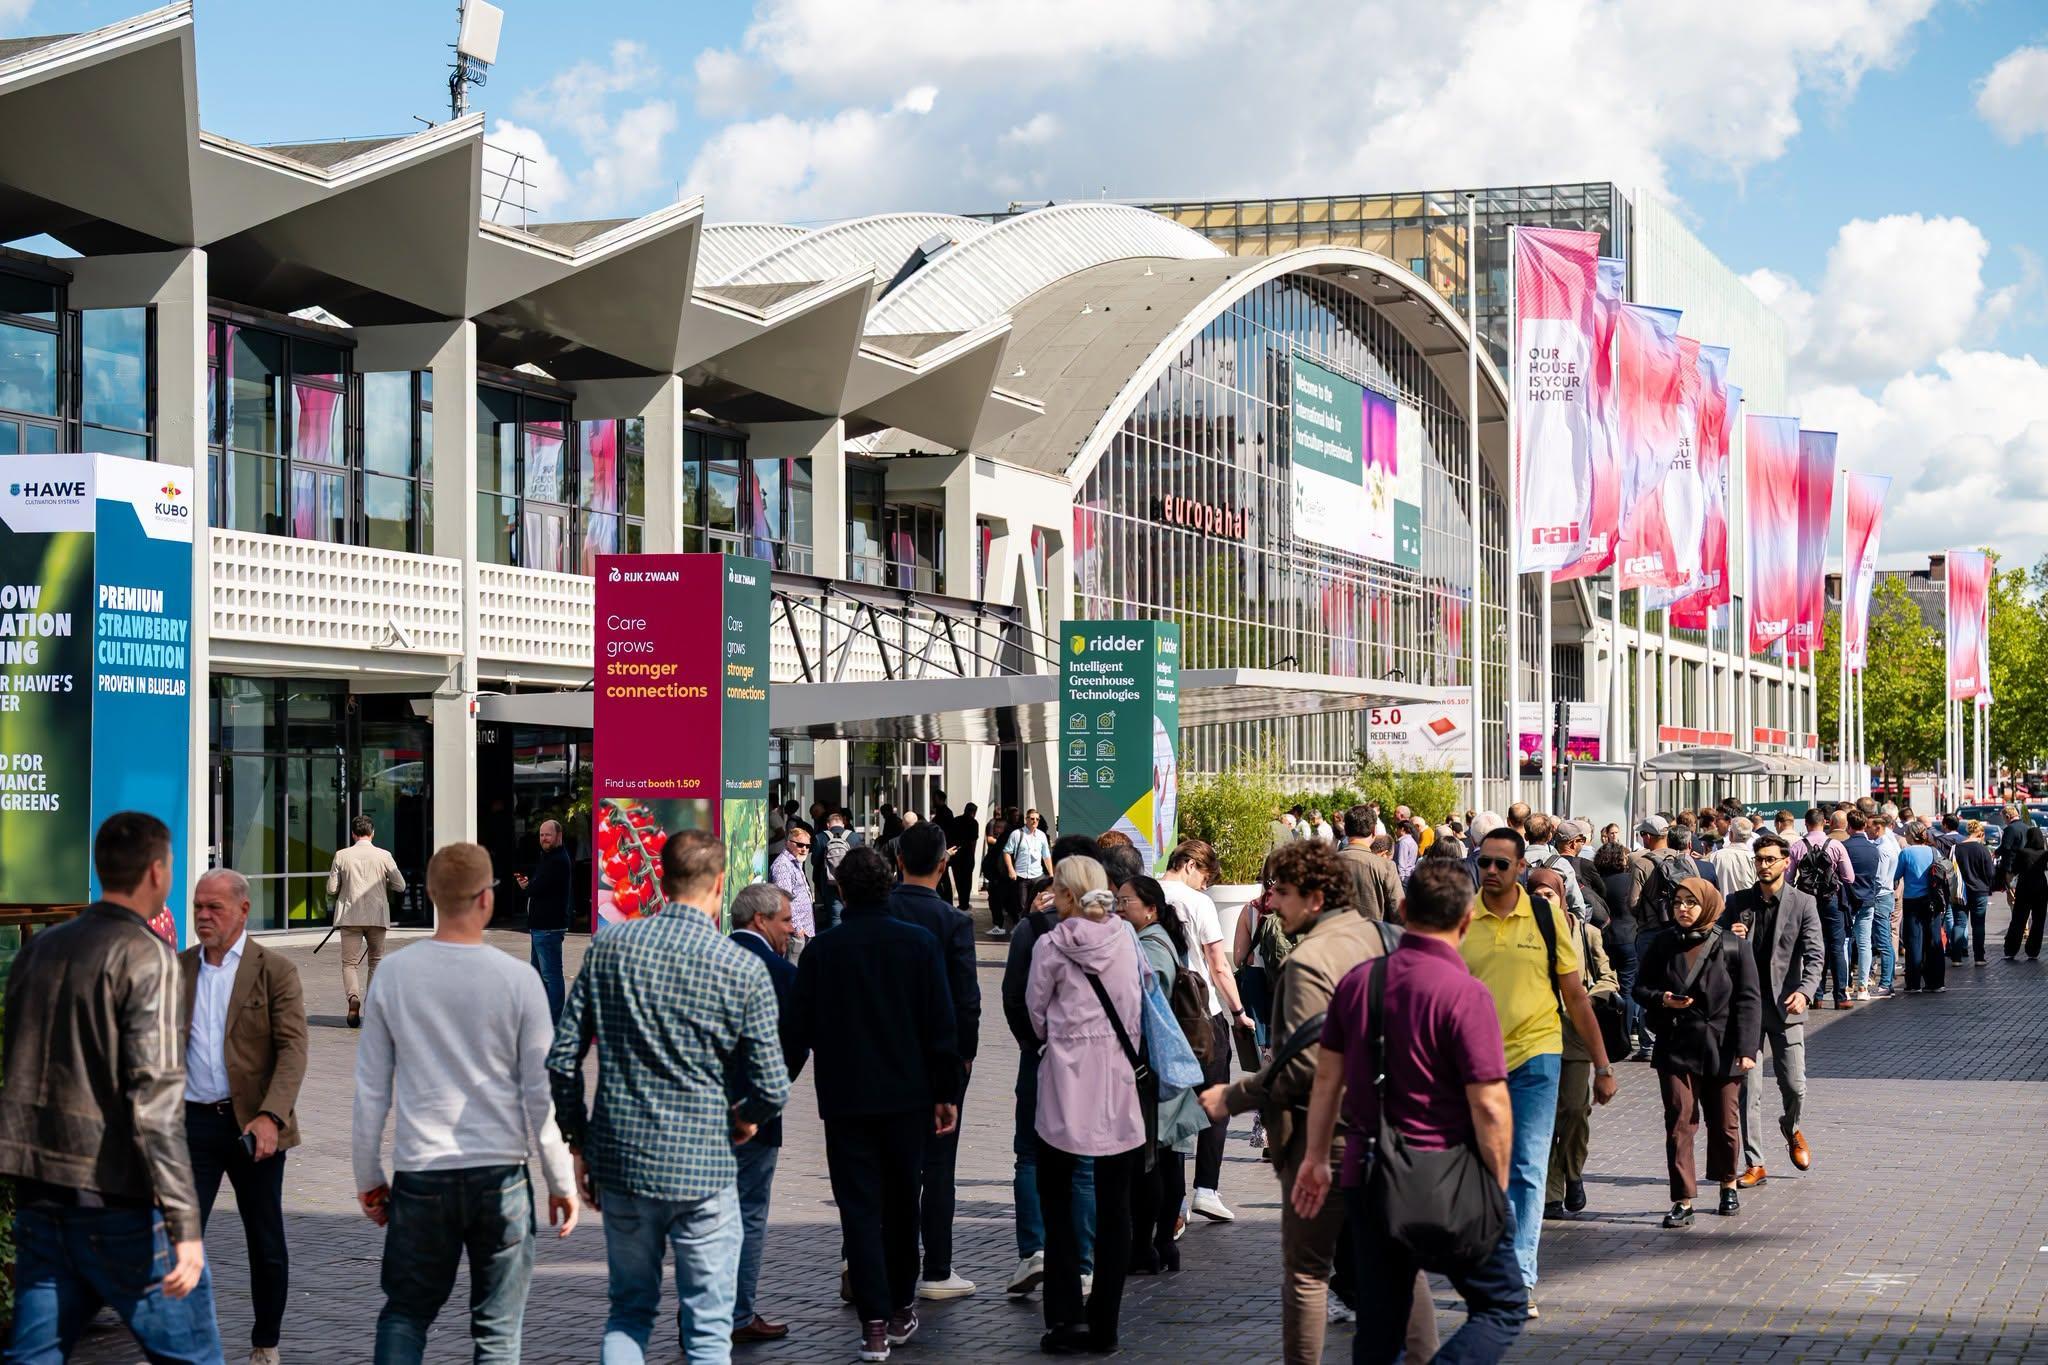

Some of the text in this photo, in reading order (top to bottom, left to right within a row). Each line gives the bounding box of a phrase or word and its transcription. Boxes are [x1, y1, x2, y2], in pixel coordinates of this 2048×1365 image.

[1529, 348, 1560, 360] OUR
[1529, 362, 1576, 374] HOUSE
[1529, 376, 1580, 388] IS YOUR
[24, 482, 86, 497] HAWE
[155, 502, 188, 517] KUBO
[1532, 522, 1580, 545] rai
[624, 571, 680, 582] RIJK ZWAAN
[0, 585, 41, 609] OW
[99, 584, 164, 614] PREMIUM
[98, 612, 188, 643] STRAWBERRY
[607, 615, 647, 631] Care
[727, 615, 743, 632] Care
[607, 640, 655, 657] grows
[727, 641, 746, 658] grows
[1089, 635, 1145, 652] ridder
[98, 640, 185, 670] CULTIVATION
[607, 661, 679, 680] stronger
[726, 662, 755, 682] stronger
[1069, 661, 1124, 674] Intelligent
[13, 674, 73, 692] HAWE'S
[98, 674, 186, 697] PROVEN IN BLUELAB
[1069, 675, 1135, 686] Greenhouse
[606, 682, 709, 698] connections
[726, 684, 766, 701] connections
[1069, 689, 1141, 702] Technologies
[0, 694, 21, 712] ER
[1371, 708, 1402, 725] 5.0
[1370, 731, 1407, 740] REDEFINED
[12, 754, 43, 771] FOR
[605, 778, 701, 788] Find us at booth 1.509
[0, 793, 60, 811] GREENS
